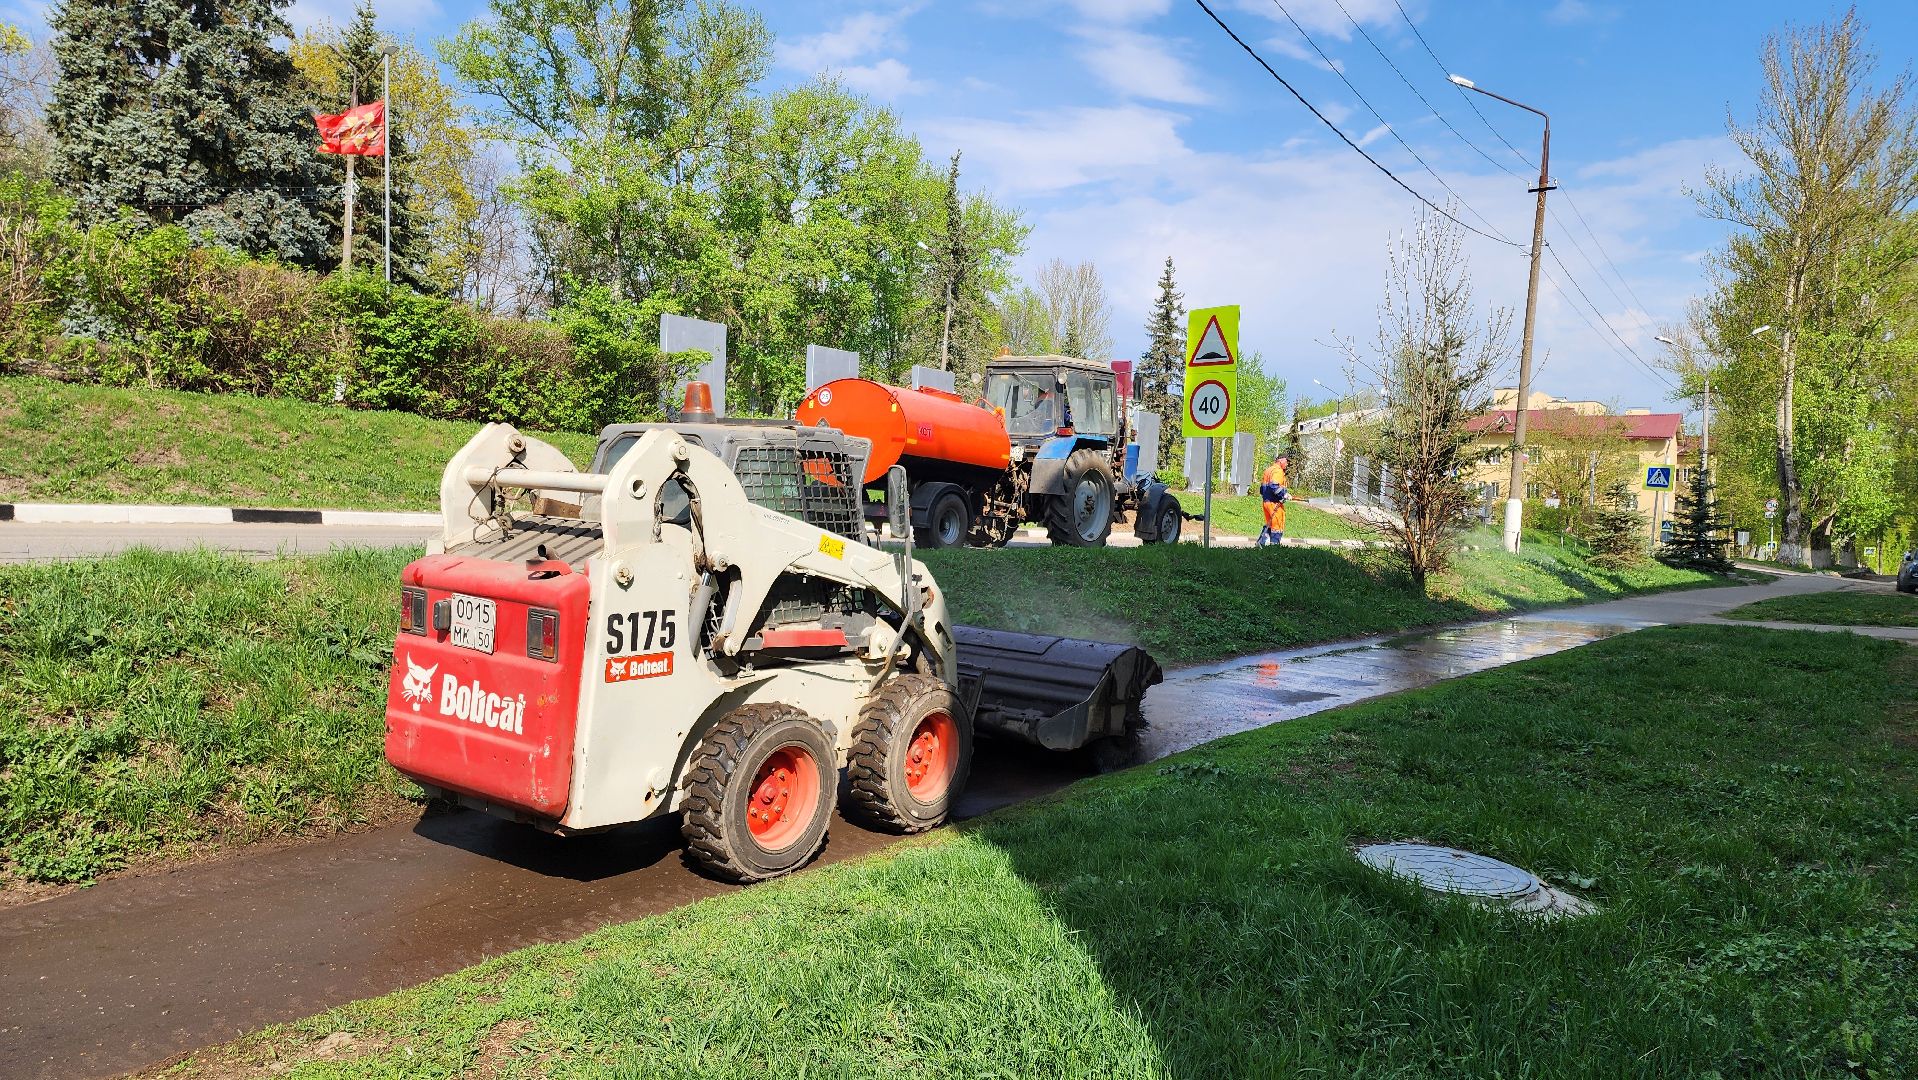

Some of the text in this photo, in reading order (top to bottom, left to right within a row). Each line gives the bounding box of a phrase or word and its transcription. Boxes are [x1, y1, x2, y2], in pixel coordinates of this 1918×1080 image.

[1199, 396, 1219, 414] 40
[457, 599, 490, 624] 0015
[453, 626, 490, 649] МК 50
[606, 609, 676, 655] S175
[629, 658, 669, 677] Bobcat
[440, 673, 526, 735] Bobcat
